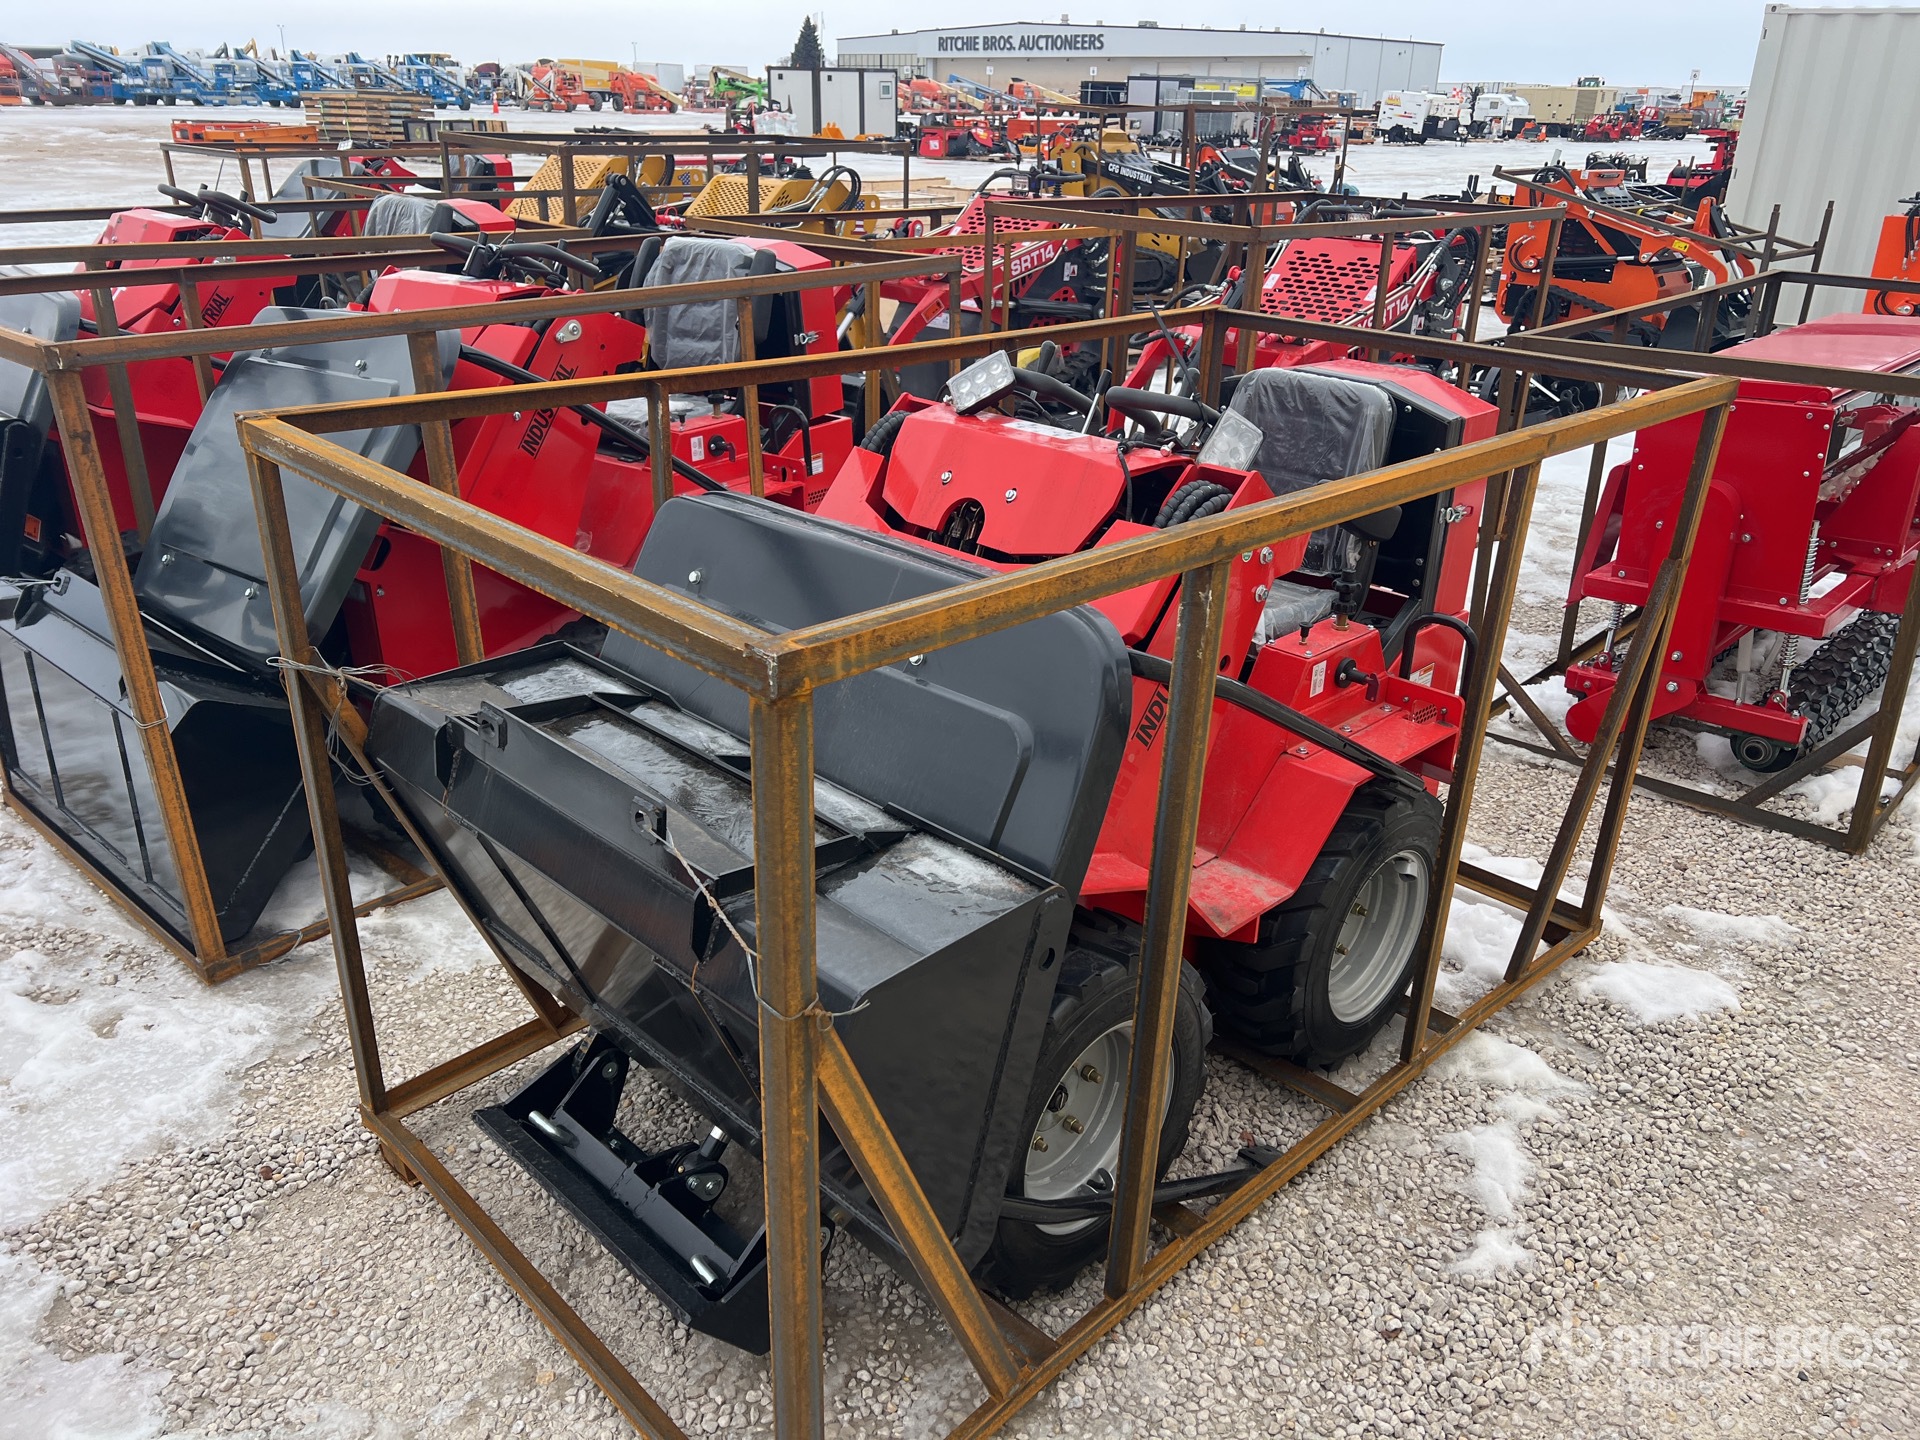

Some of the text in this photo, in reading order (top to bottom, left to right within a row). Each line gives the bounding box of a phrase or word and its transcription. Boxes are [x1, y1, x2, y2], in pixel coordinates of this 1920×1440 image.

[938, 34, 1104, 52] RITCHIE BROS. AUCTIONEERS
[1108, 162, 1153, 185] CFG INDUSTRIAL
[1000, 244, 1055, 276] SRT14
[521, 364, 575, 457] INDUSAL
